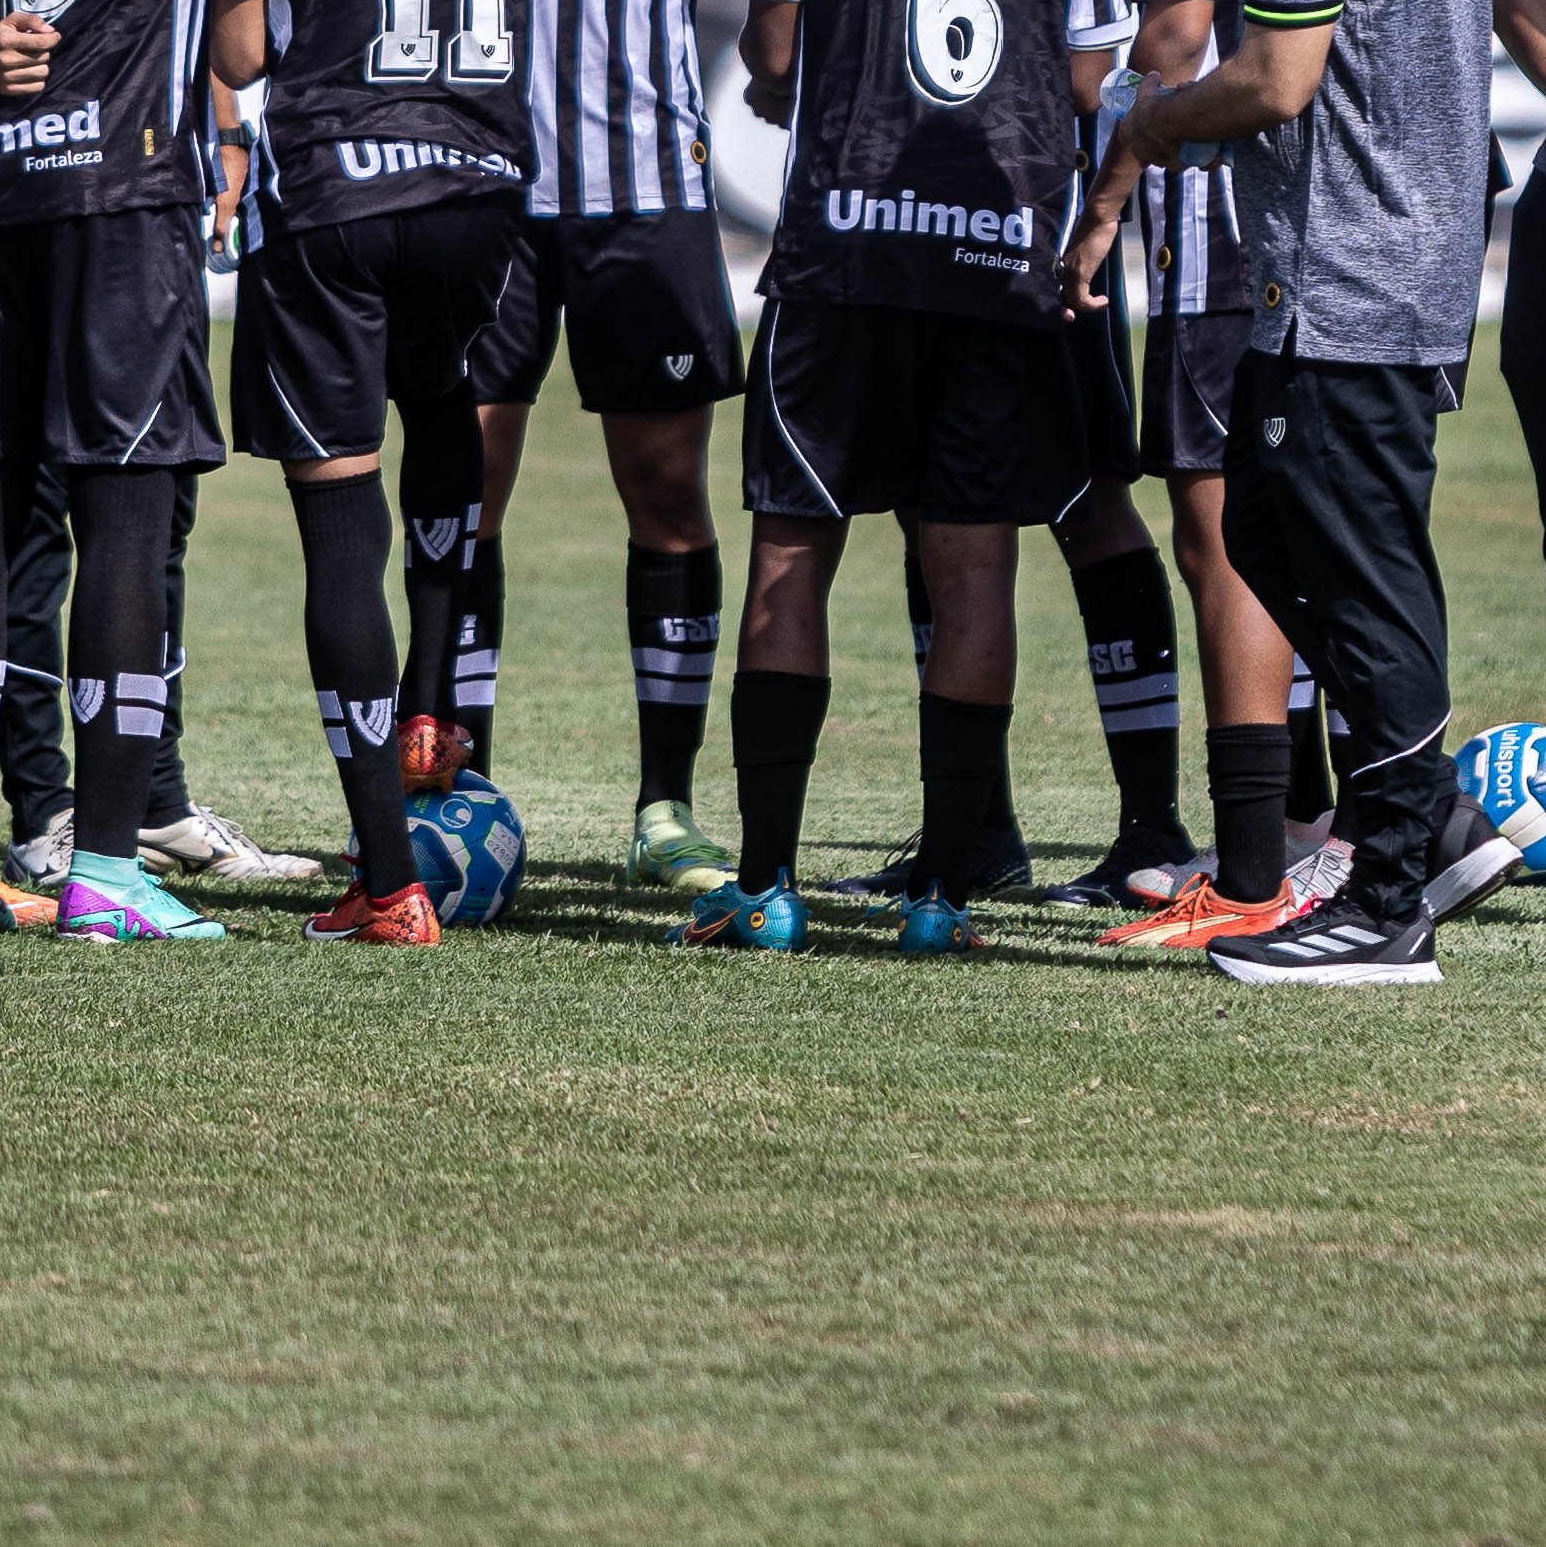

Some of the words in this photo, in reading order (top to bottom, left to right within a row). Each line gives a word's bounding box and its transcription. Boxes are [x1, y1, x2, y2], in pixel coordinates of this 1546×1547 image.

[26, 151, 103, 171] Fortaleza
[828, 189, 1034, 248] Unimed
[955, 248, 1030, 273] Fortaleza
[1493, 729, 1521, 809] uhlsport
